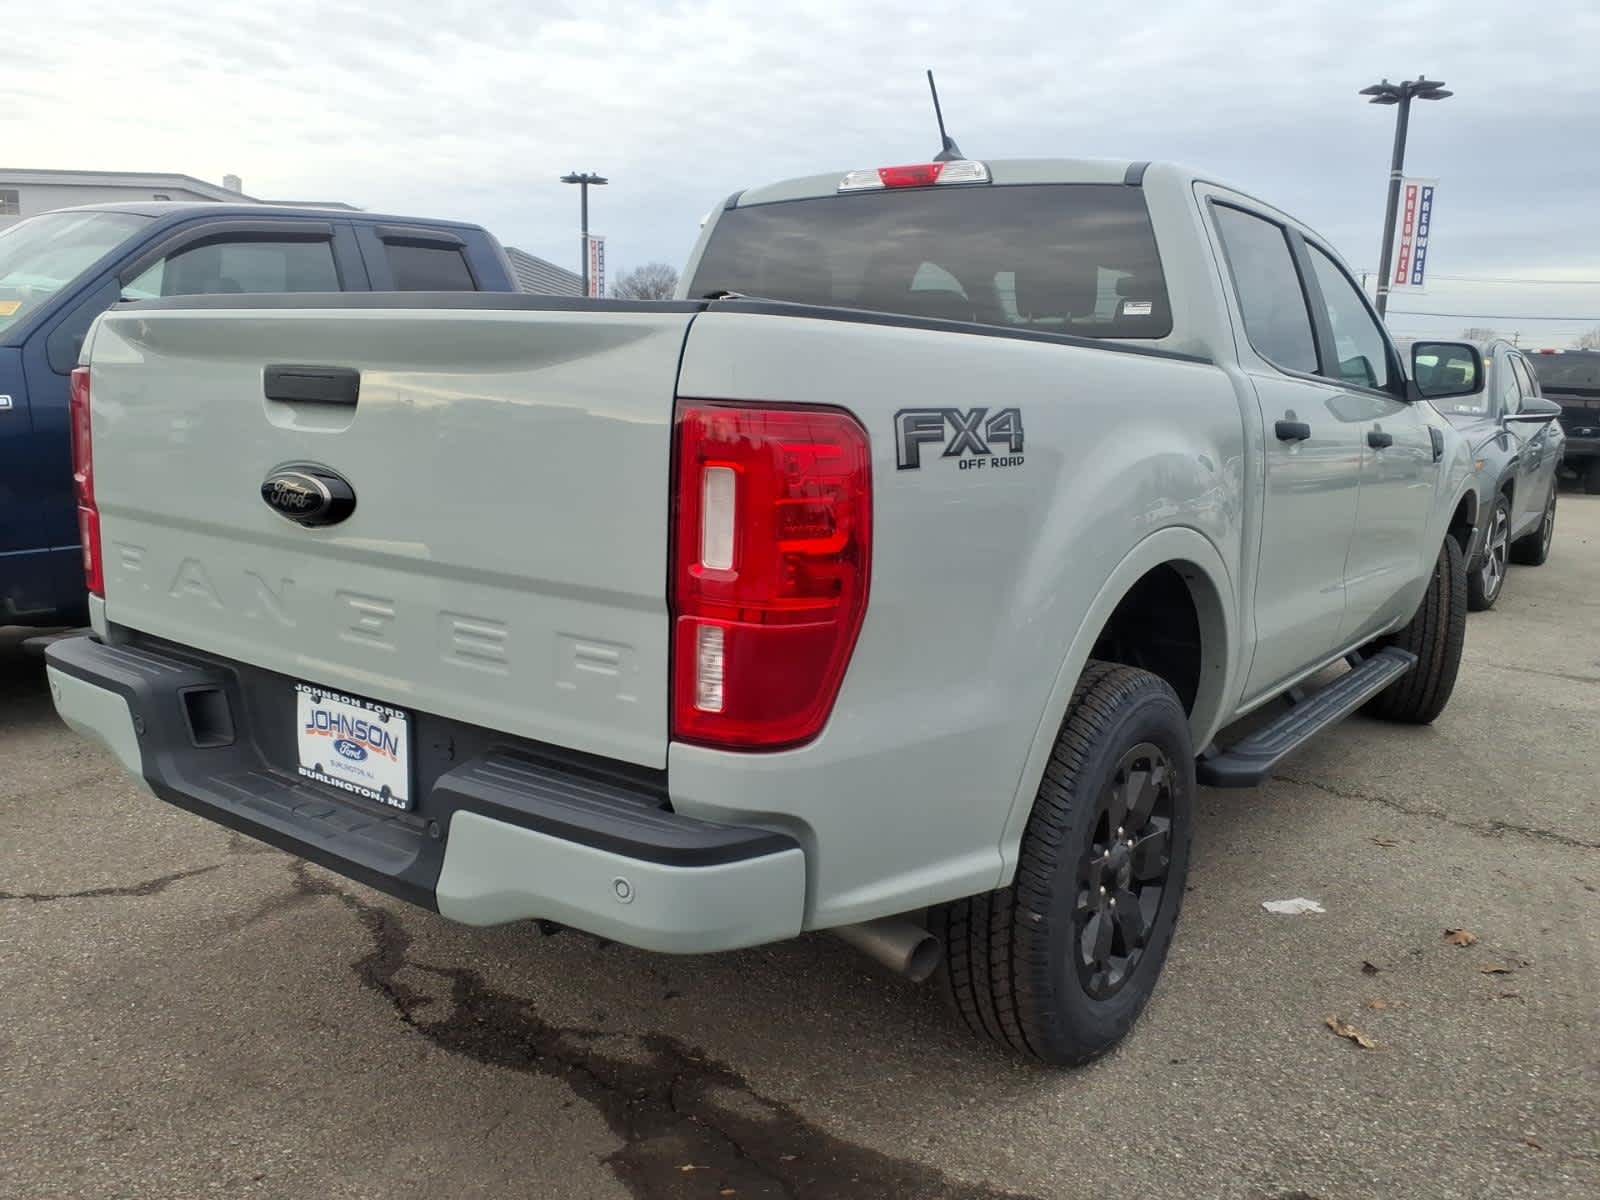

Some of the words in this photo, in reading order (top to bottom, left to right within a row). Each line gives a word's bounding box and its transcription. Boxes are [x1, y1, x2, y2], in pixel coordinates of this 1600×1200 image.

[893, 408, 1025, 470] FX4
[959, 459, 986, 470] OFF
[991, 456, 1025, 468] ROAD
[271, 479, 313, 508] Ford
[110, 540, 638, 704] RANGER
[295, 683, 362, 707] JOHNSON
[366, 702, 405, 719] FORD
[304, 708, 399, 757] JOHNSON
[339, 740, 363, 760] Ford
[298, 767, 385, 803] BURLINGTON,
[388, 798, 406, 809] NJ
